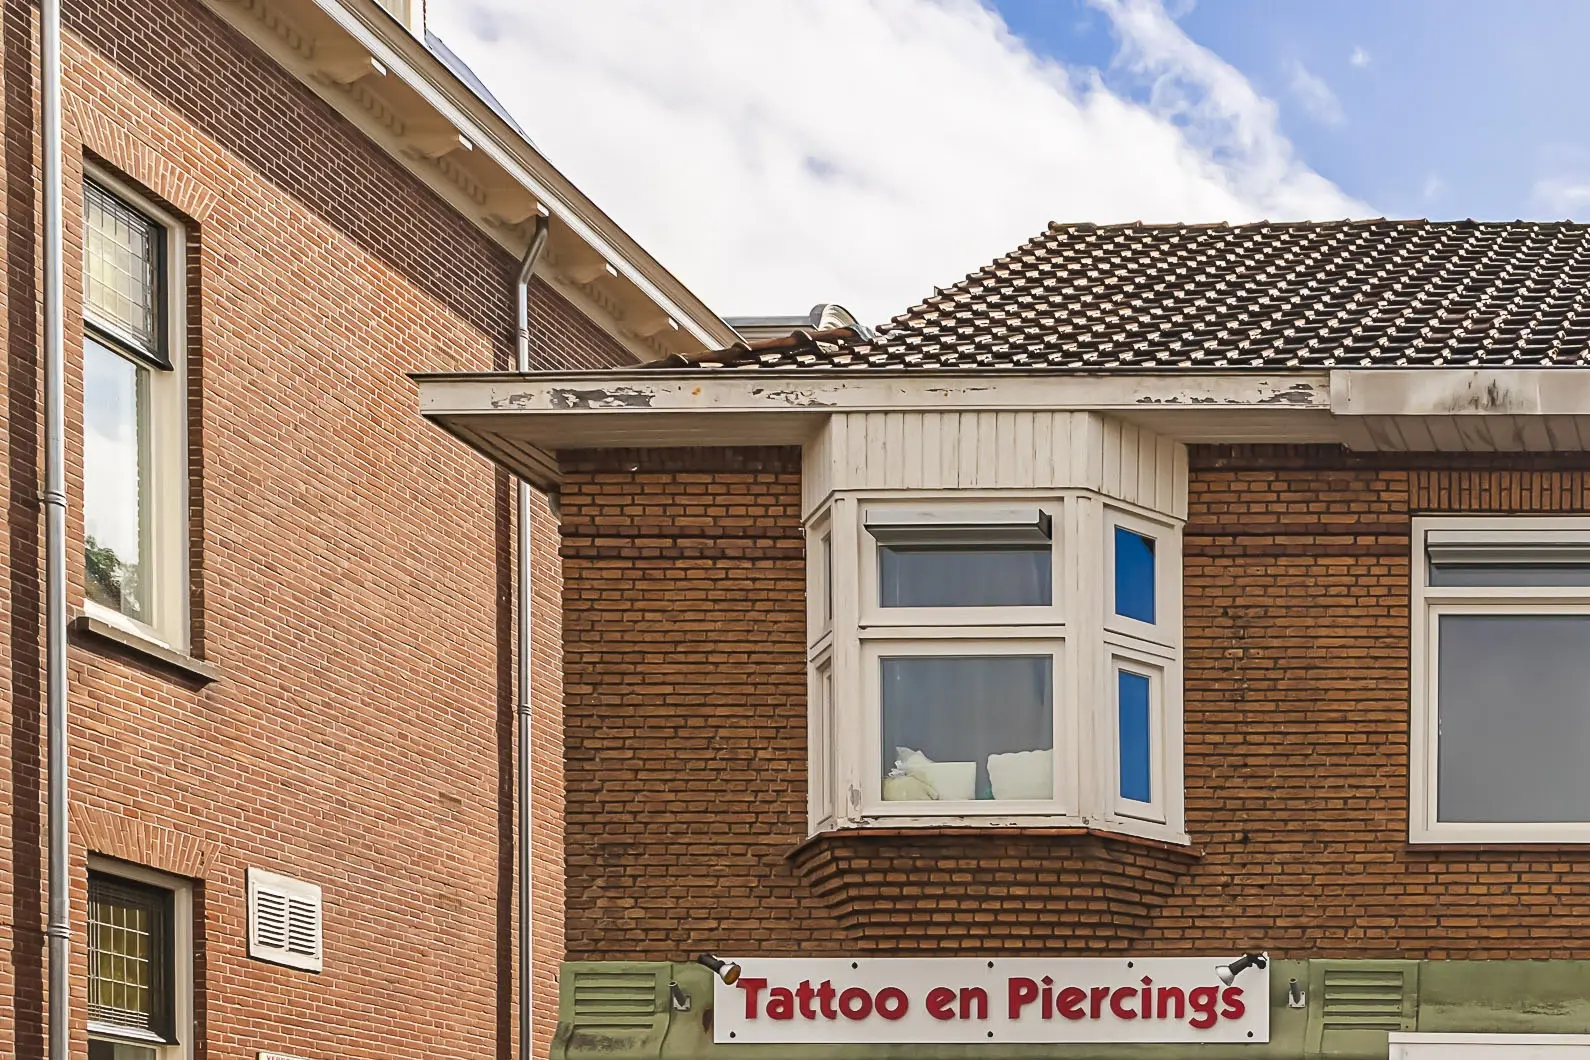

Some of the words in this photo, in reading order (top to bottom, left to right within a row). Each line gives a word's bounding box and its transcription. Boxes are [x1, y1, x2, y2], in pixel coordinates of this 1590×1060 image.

[735, 977, 909, 1020] Tattoo
[925, 986, 988, 1020] en
[1008, 975, 1246, 1029] Piercings
